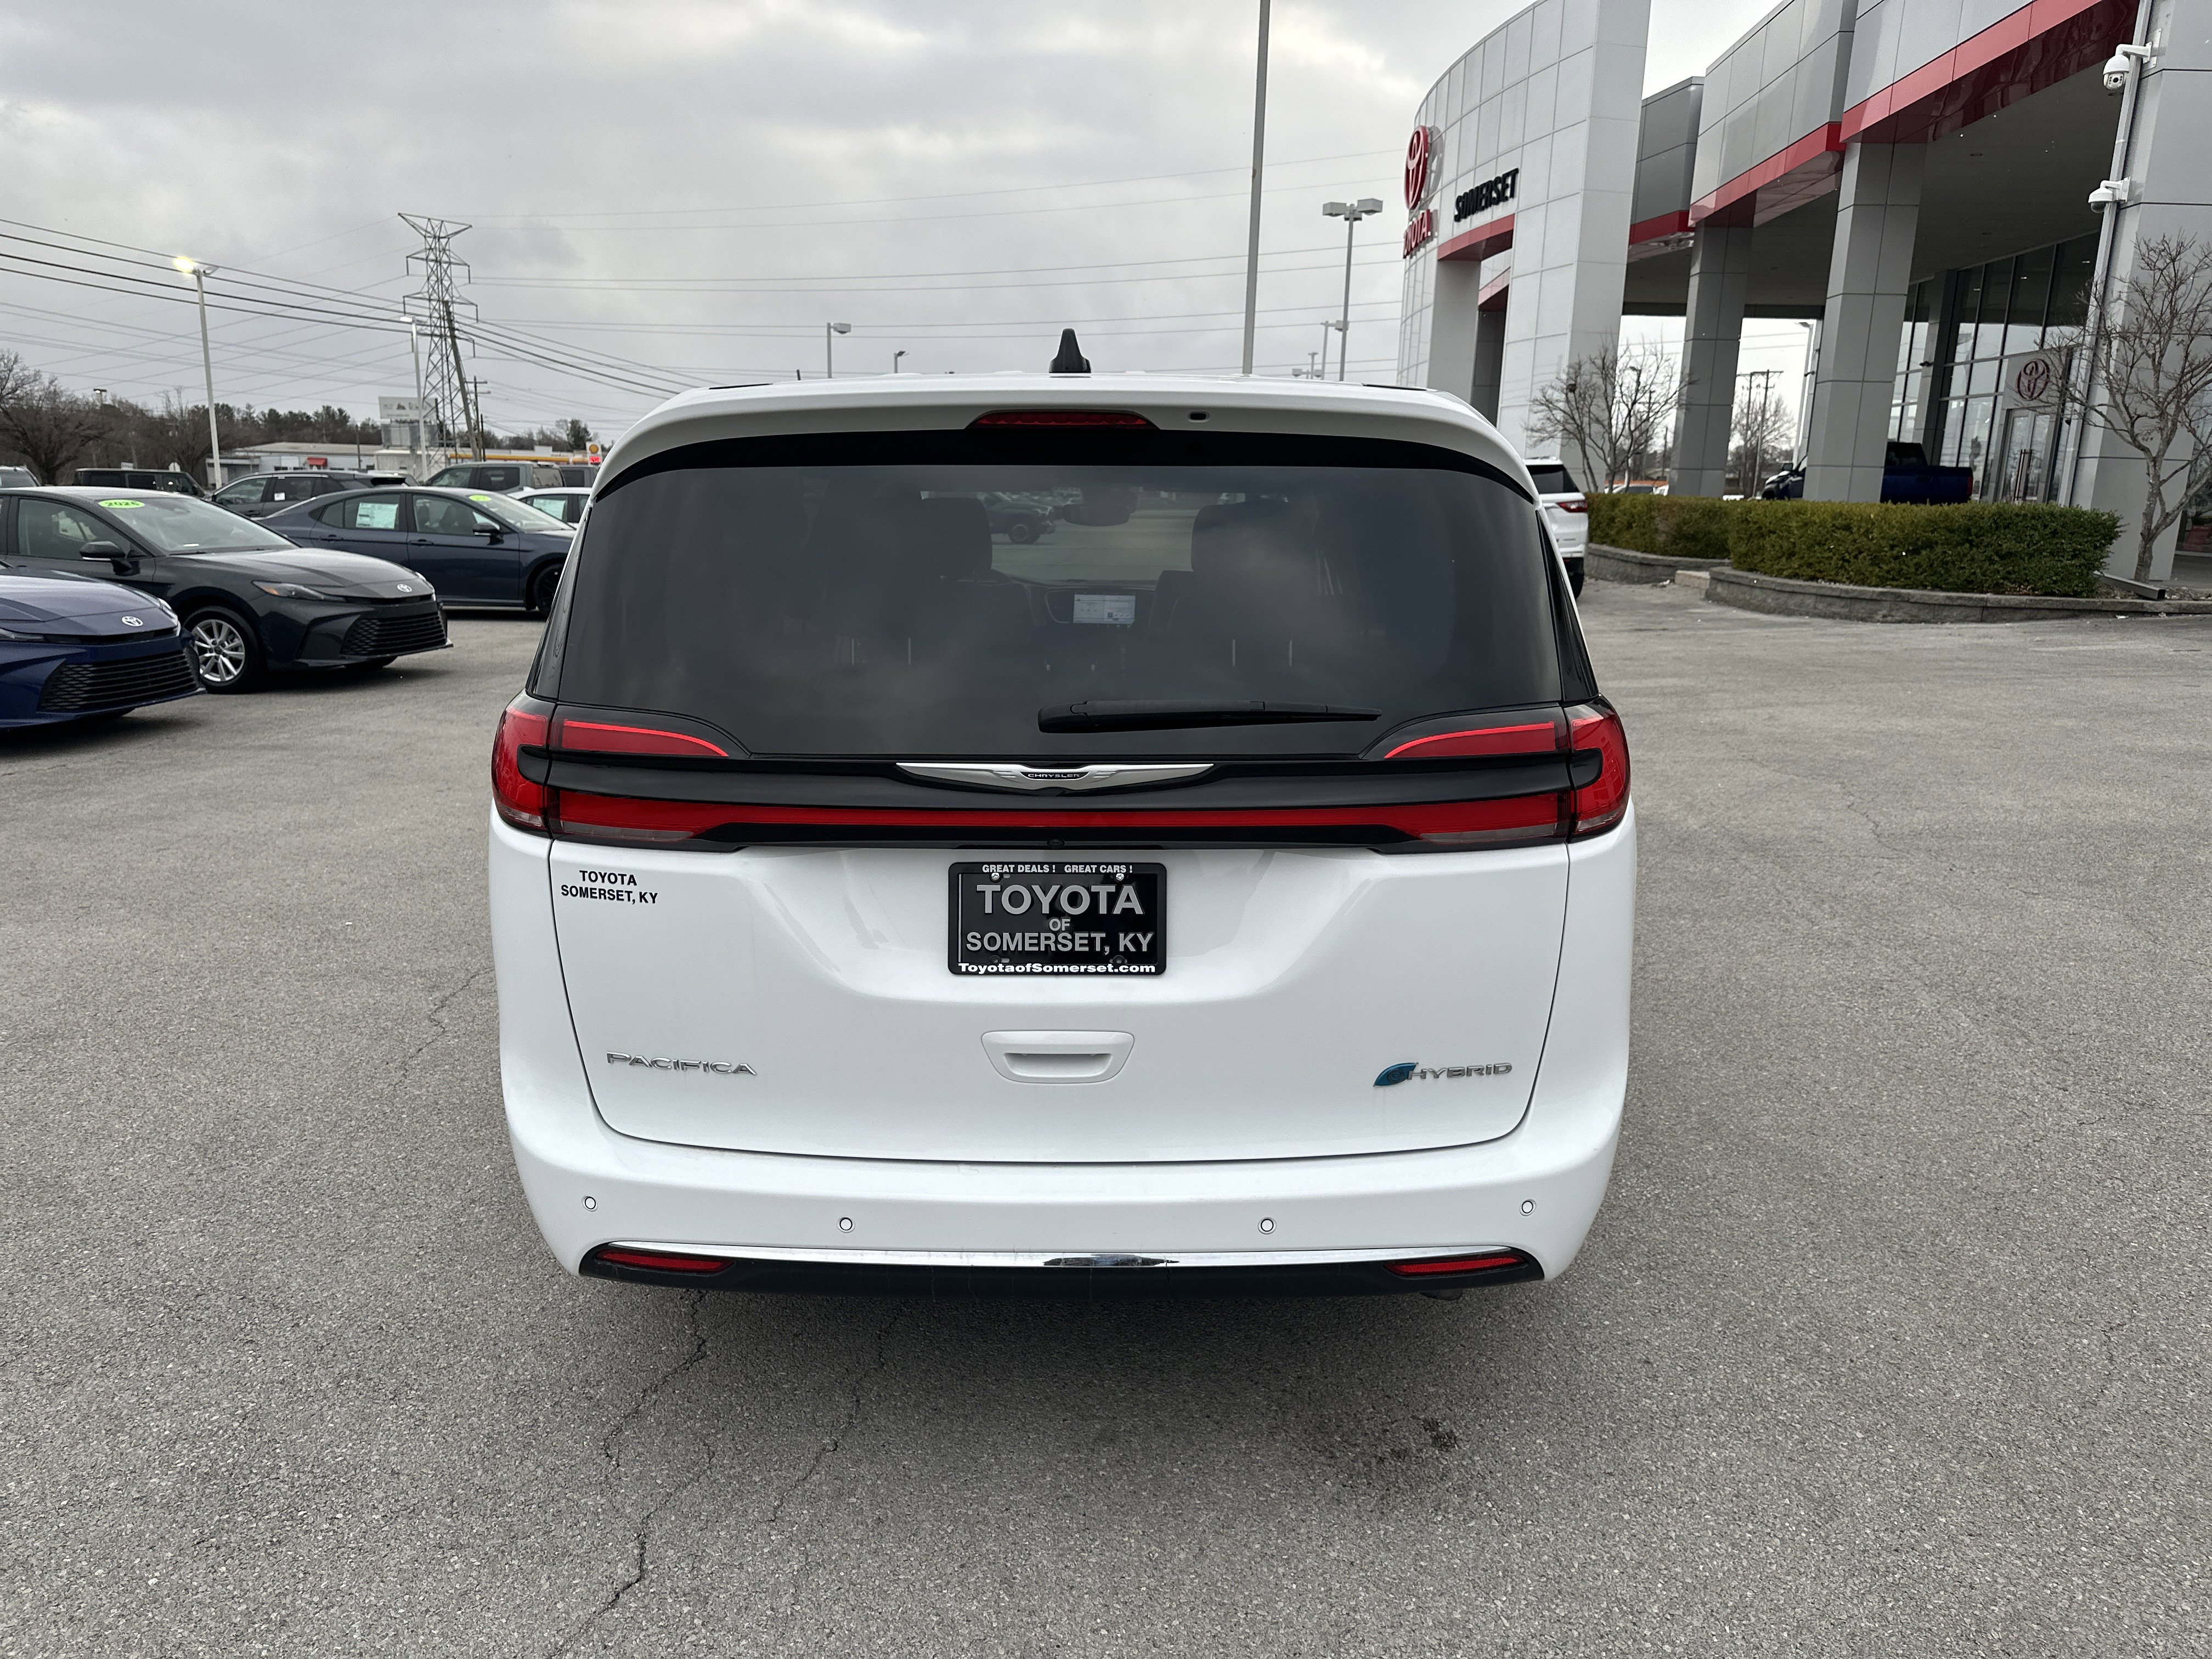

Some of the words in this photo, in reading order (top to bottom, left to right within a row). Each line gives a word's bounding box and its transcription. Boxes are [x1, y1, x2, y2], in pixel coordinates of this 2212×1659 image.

[1454, 167, 1519, 222] SOMERSET
[1403, 209, 1431, 259] OYOTA
[579, 870, 637, 886] TOYOTA
[982, 865, 1014, 873] GREAT
[1064, 865, 1097, 873] GREAT
[561, 884, 635, 905] SOMERSET,
[639, 891, 658, 904] KY
[976, 884, 1144, 915] TOYOTA
[1049, 918, 1071, 932] OF
[966, 932, 1110, 955] SOMERSET,
[1119, 932, 1154, 952] KY
[958, 963, 1155, 974] ToyotaofSomerset.com
[606, 1051, 757, 1076] PACIFICA
